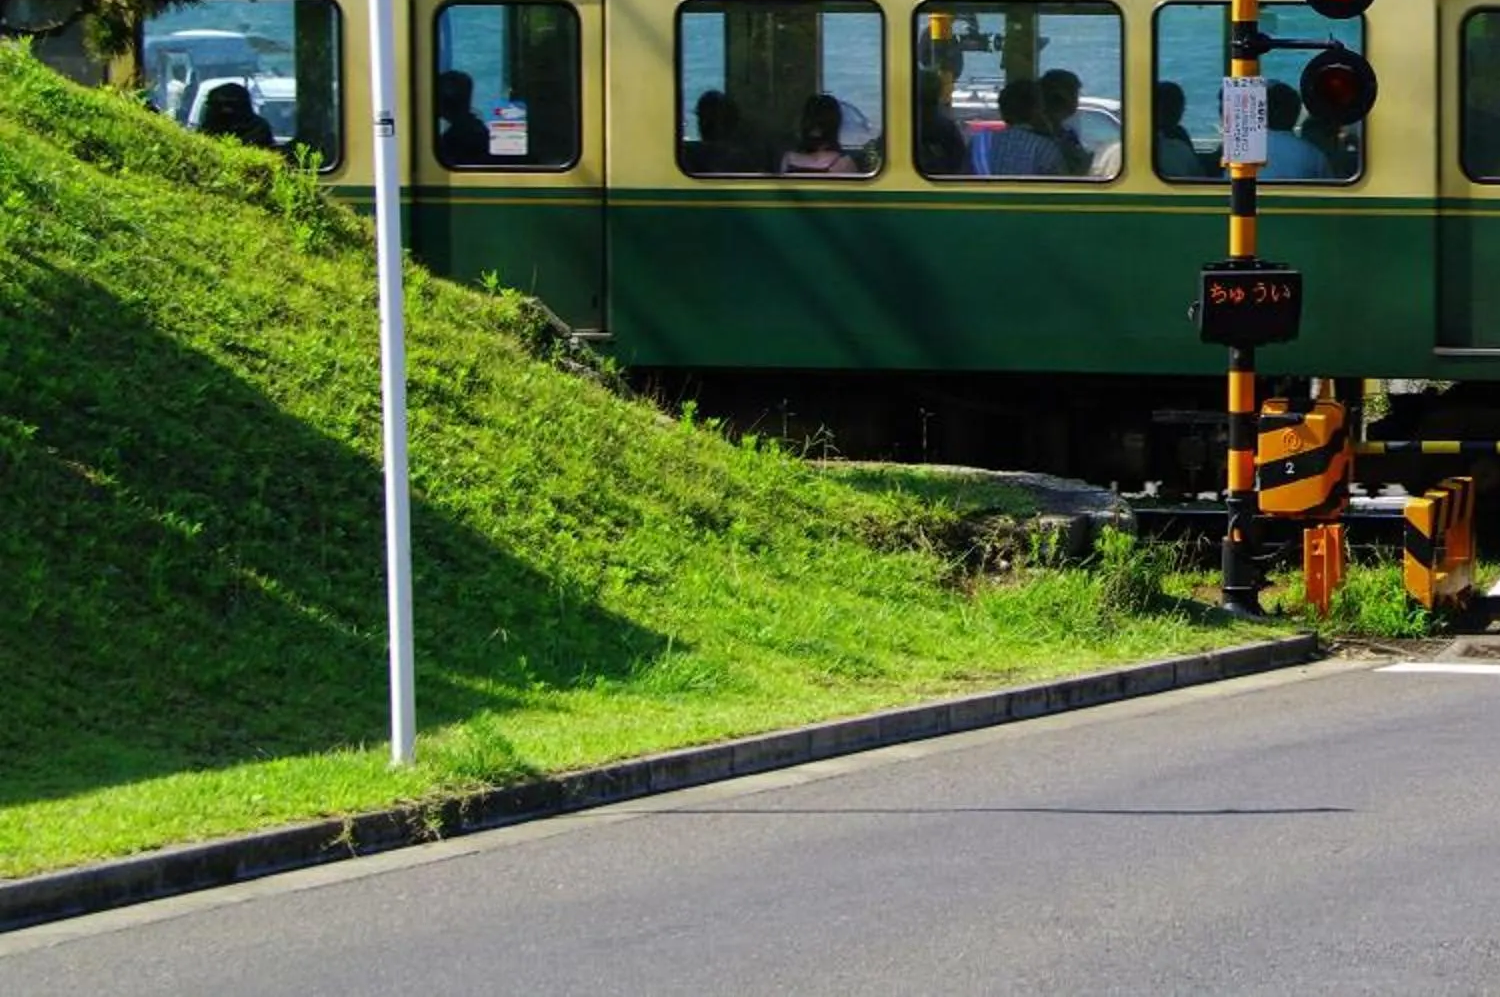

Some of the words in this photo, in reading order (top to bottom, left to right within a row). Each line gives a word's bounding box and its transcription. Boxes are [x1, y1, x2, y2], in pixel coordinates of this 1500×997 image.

[1210, 282, 1291, 304] ちゅうい
[1285, 462, 1295, 474] 2
